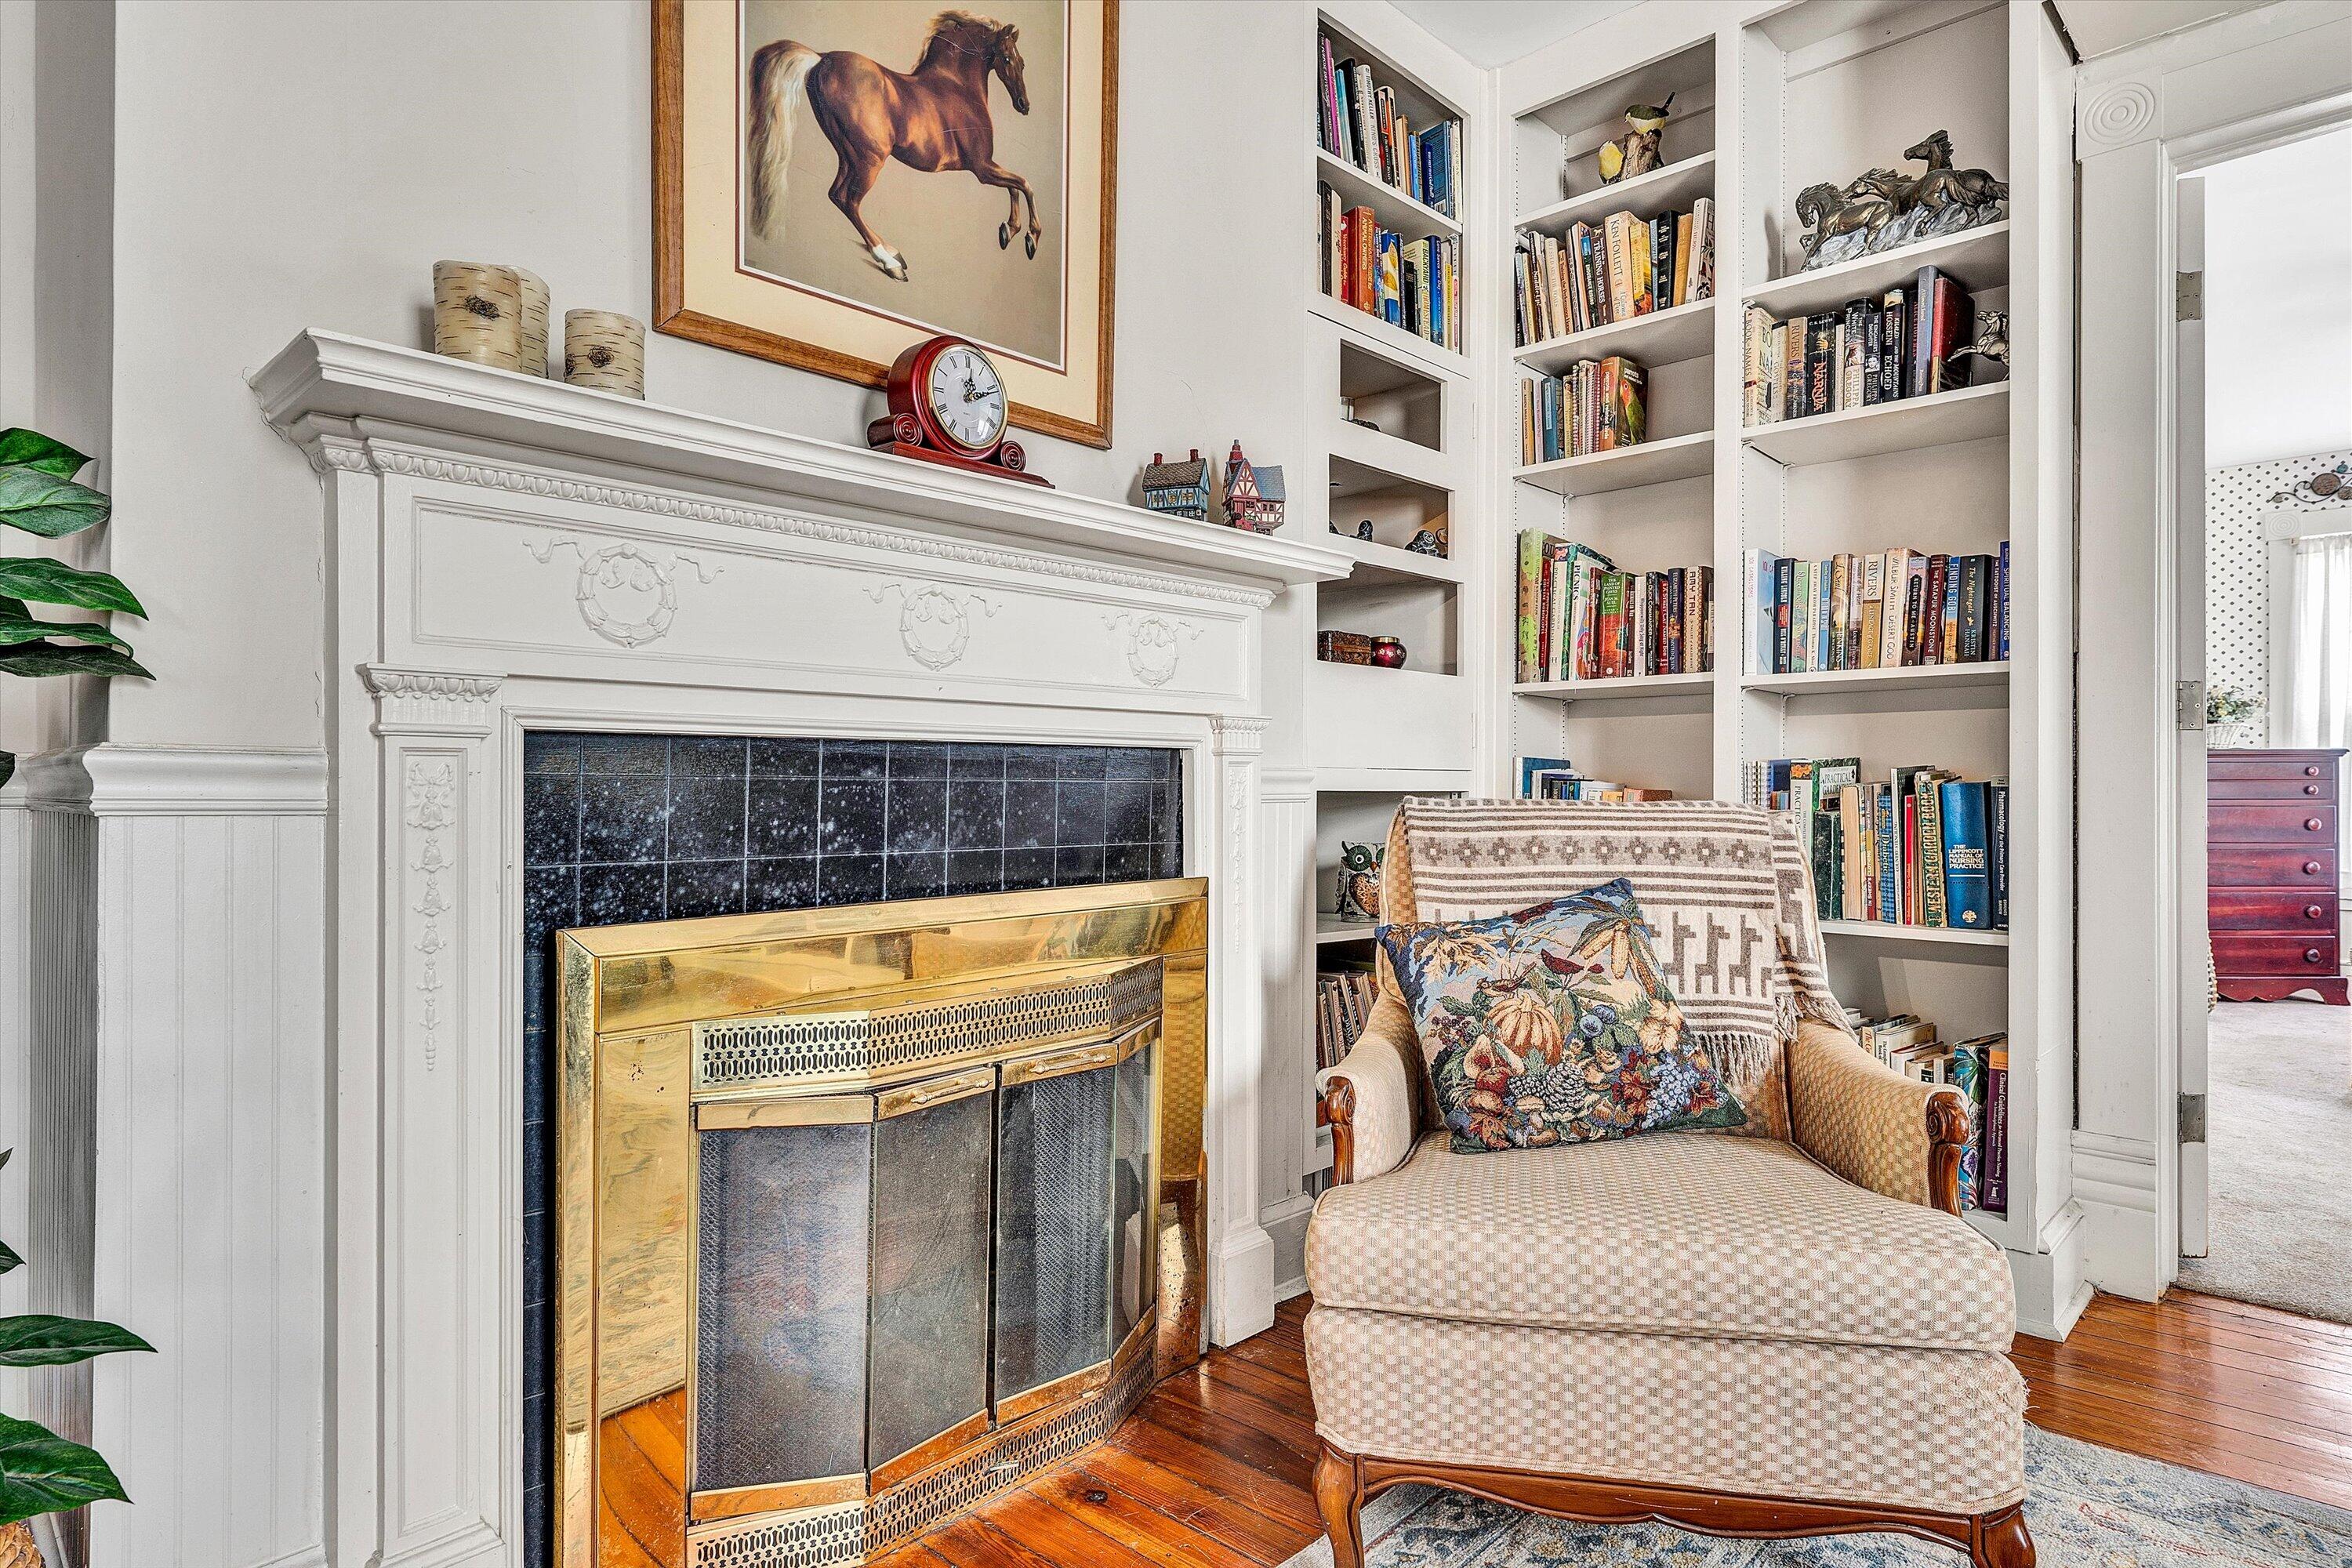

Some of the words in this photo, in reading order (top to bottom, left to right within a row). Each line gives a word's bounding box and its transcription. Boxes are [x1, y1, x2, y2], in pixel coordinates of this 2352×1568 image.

[1610, 220, 1620, 239] KEN
[1593, 241, 1602, 276] TRAINING
[1612, 239, 1624, 277] FOLLETT
[1597, 276, 1606, 303] HORSES
[1791, 325, 1800, 358] RIVERS
[1811, 361, 1828, 412] NARNIA
[1884, 355, 1893, 390] ECHOED
[1573, 565, 1581, 601] PICNICS
[1835, 570, 1846, 592] Saul
[1867, 561, 1878, 597] RIVERS
[1890, 556, 1900, 584] WILBUR
[1949, 564, 1958, 593] FINDING
[1889, 586, 1899, 611] SMITH
[1931, 580, 1940, 608] SATAPUR
[1947, 596, 1957, 613] GOBI
[1966, 579, 1976, 614] Nightingale
[1888, 615, 1896, 641] DESERT
[1927, 610, 1936, 653] MOONSTONE
[1886, 641, 1896, 659] GOD
[1824, 771, 1852, 784] PRACTICAL
[1921, 791, 1935, 819] BOOK
[1997, 791, 2006, 833] Pharmacology
[1881, 833, 1891, 875] Diabetic
[1922, 822, 1938, 862] GARDEN
[1925, 863, 1941, 913] WESTERN
[1348, 986, 1359, 1021] INSTANT
[1998, 1073, 2007, 1094] Clinical
[1997, 1095, 2005, 1123] Guidelines
